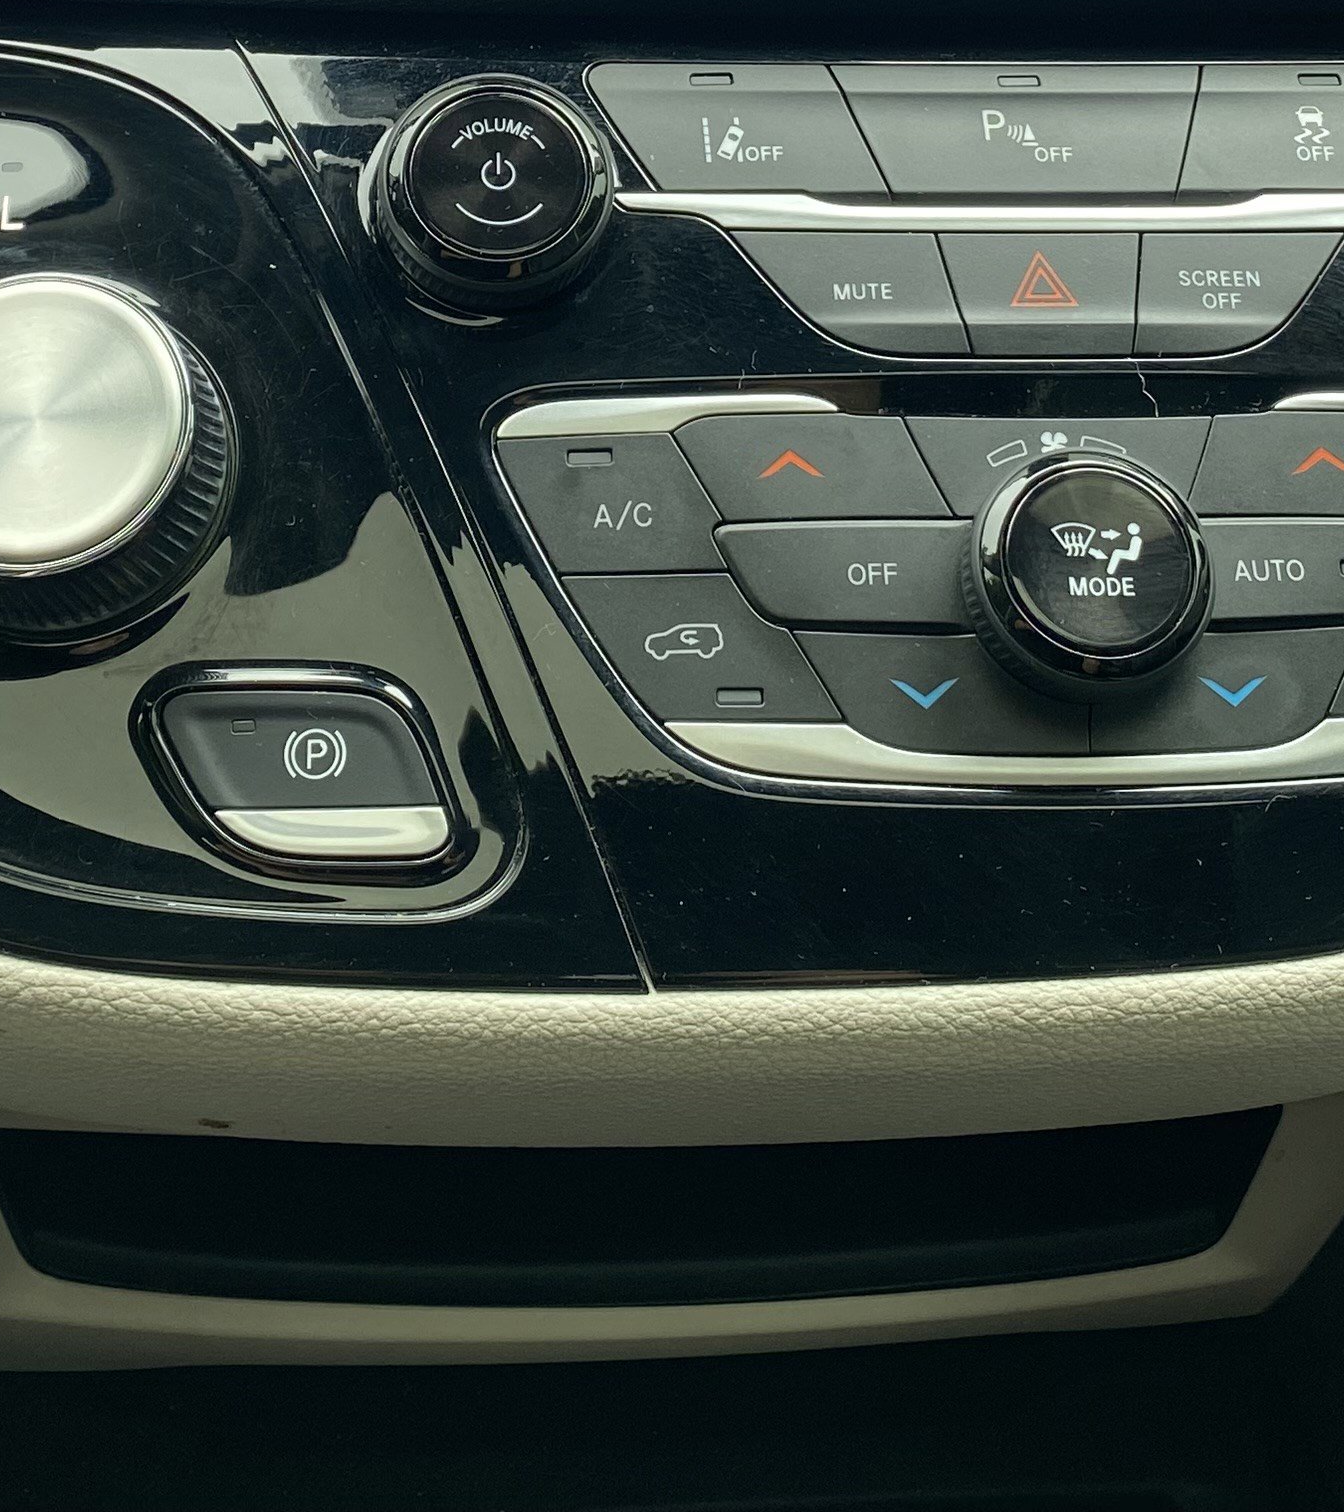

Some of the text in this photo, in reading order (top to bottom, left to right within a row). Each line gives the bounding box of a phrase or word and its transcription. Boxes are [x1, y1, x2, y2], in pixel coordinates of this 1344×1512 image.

[459, 118, 533, 142] VOLUME
[746, 146, 783, 162] OFF
[1034, 147, 1073, 163] OFF
[1296, 147, 1334, 162] OFF
[1179, 269, 1261, 287] SCREEN
[832, 283, 893, 300] MUTE
[1202, 293, 1242, 309] OFF
[593, 500, 652, 530] A/C
[847, 563, 897, 585] OFF
[1235, 560, 1305, 581] AUTO
[1069, 577, 1135, 597] MODE
